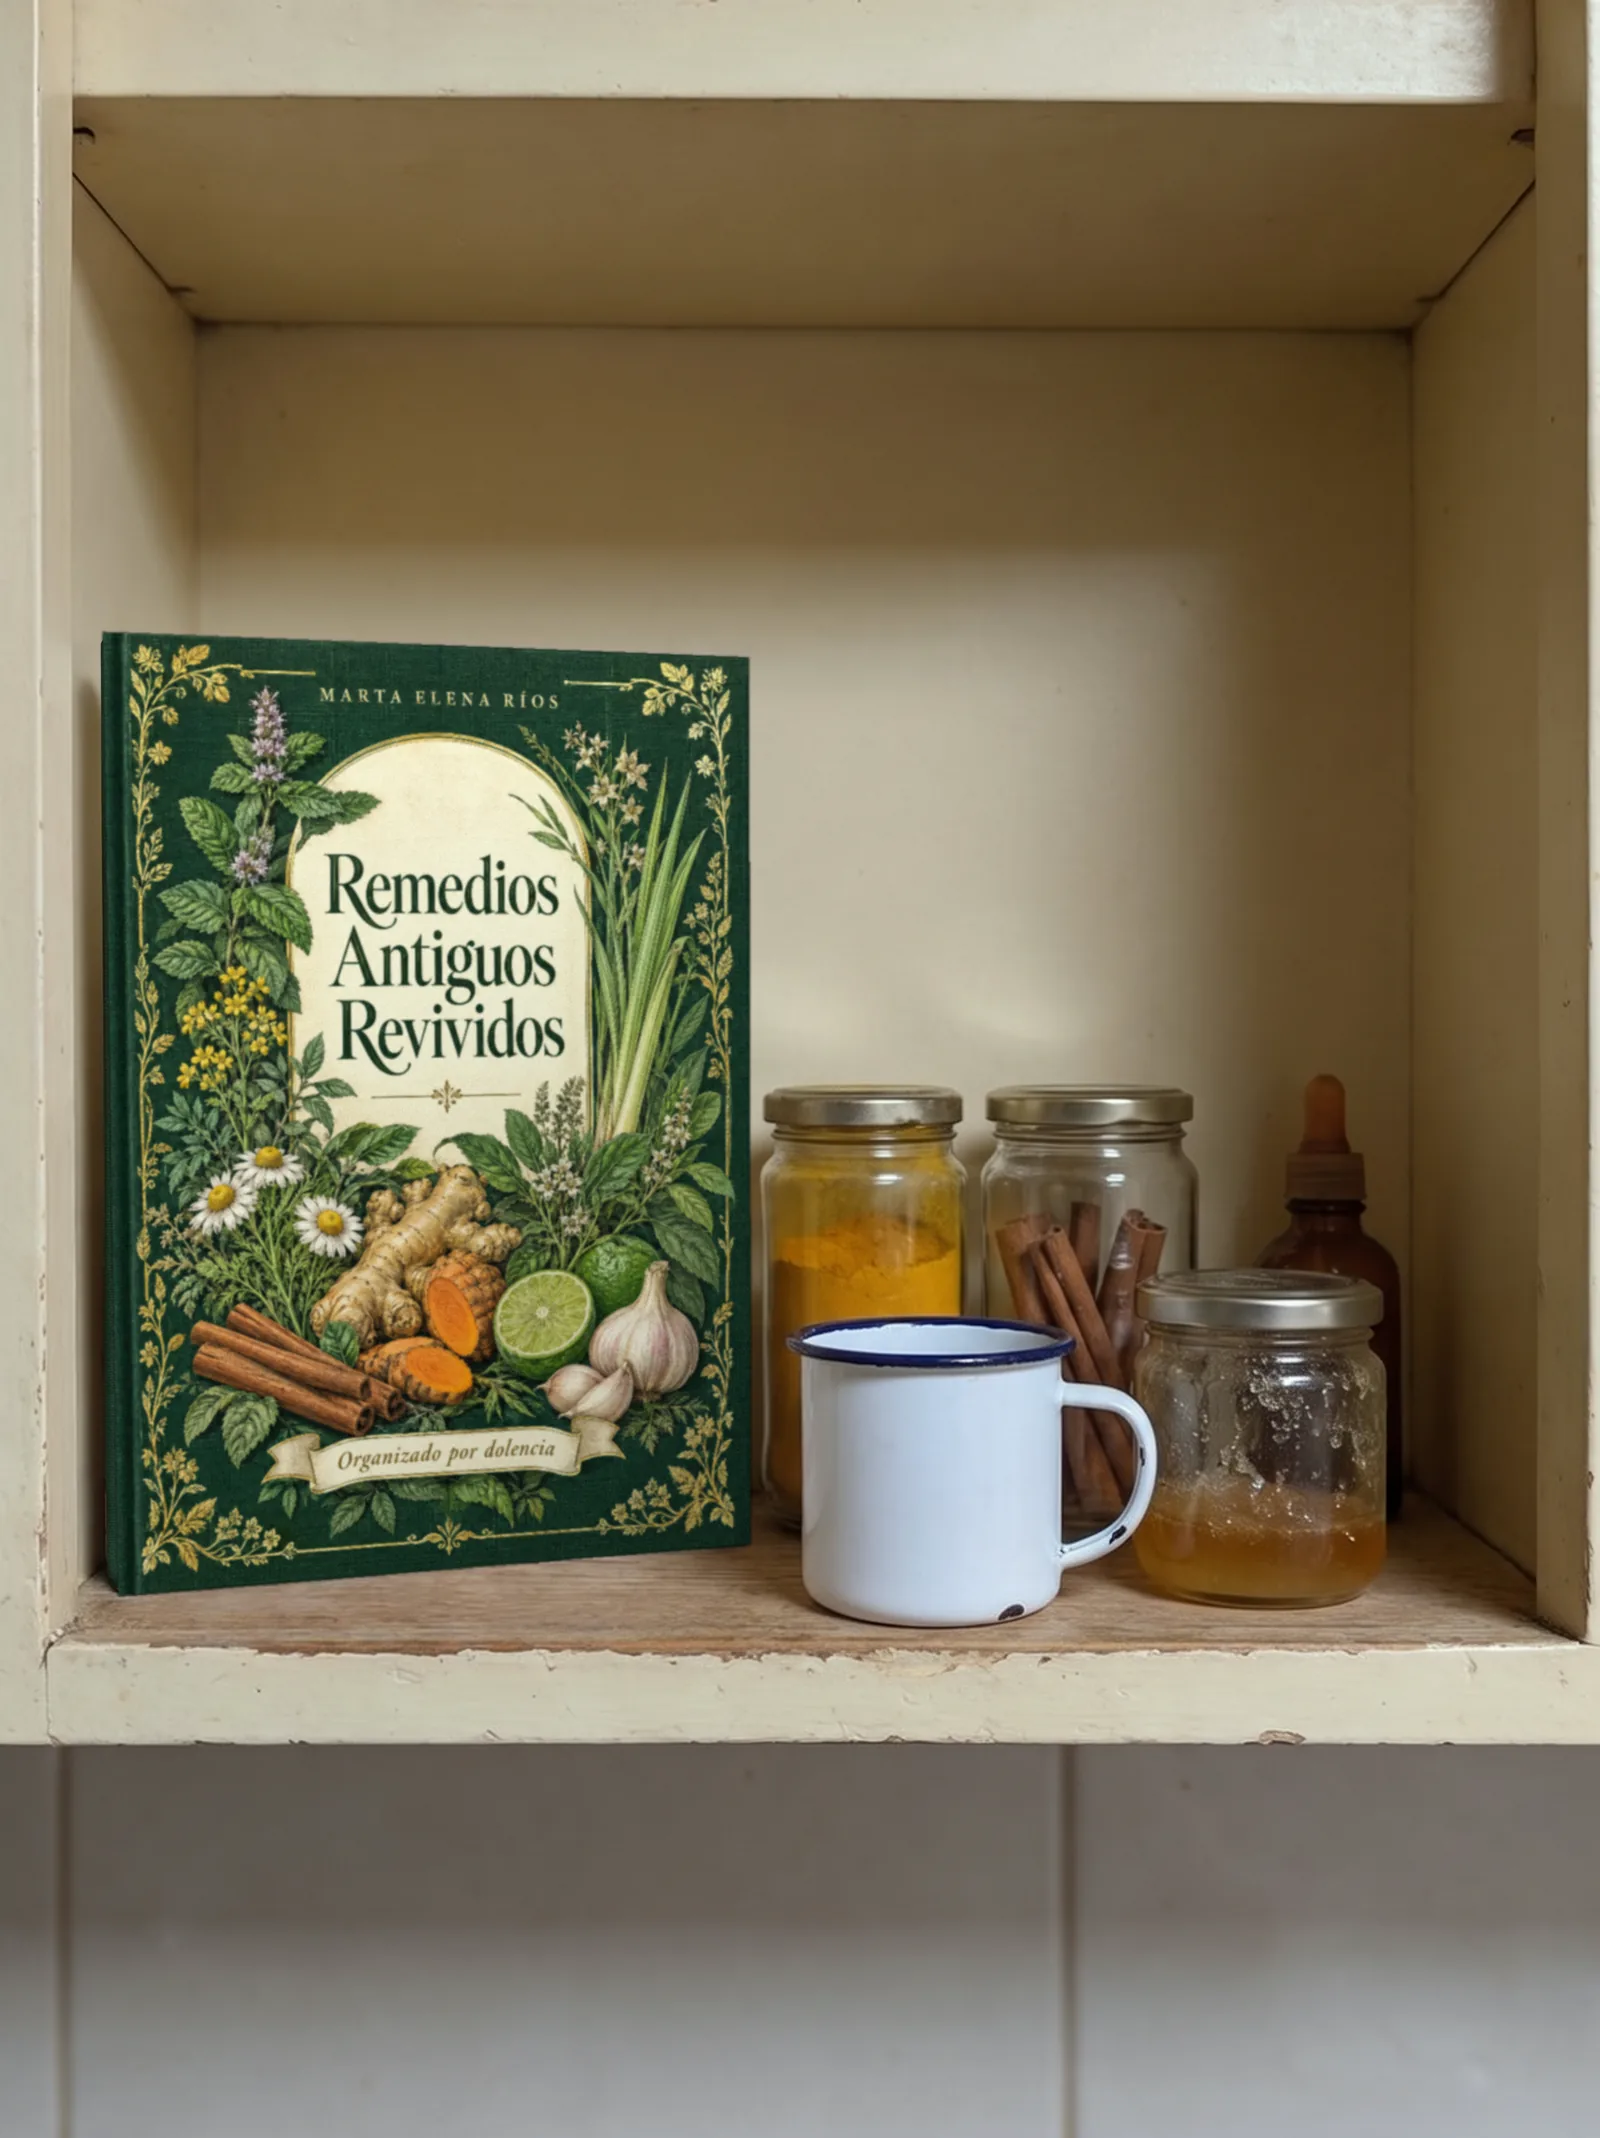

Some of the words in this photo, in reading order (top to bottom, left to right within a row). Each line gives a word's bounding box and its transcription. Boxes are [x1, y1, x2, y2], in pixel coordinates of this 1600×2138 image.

[319, 687, 402, 704] MARTA
[415, 690, 491, 707] ELENA
[503, 690, 560, 709] RÍOS
[324, 853, 560, 930] Remedios
[328, 925, 557, 1006] Antiguos
[336, 997, 566, 1077] Revividos
[337, 1442, 442, 1473] Organizado
[446, 1444, 478, 1467] por
[483, 1438, 556, 1460] dolencia
